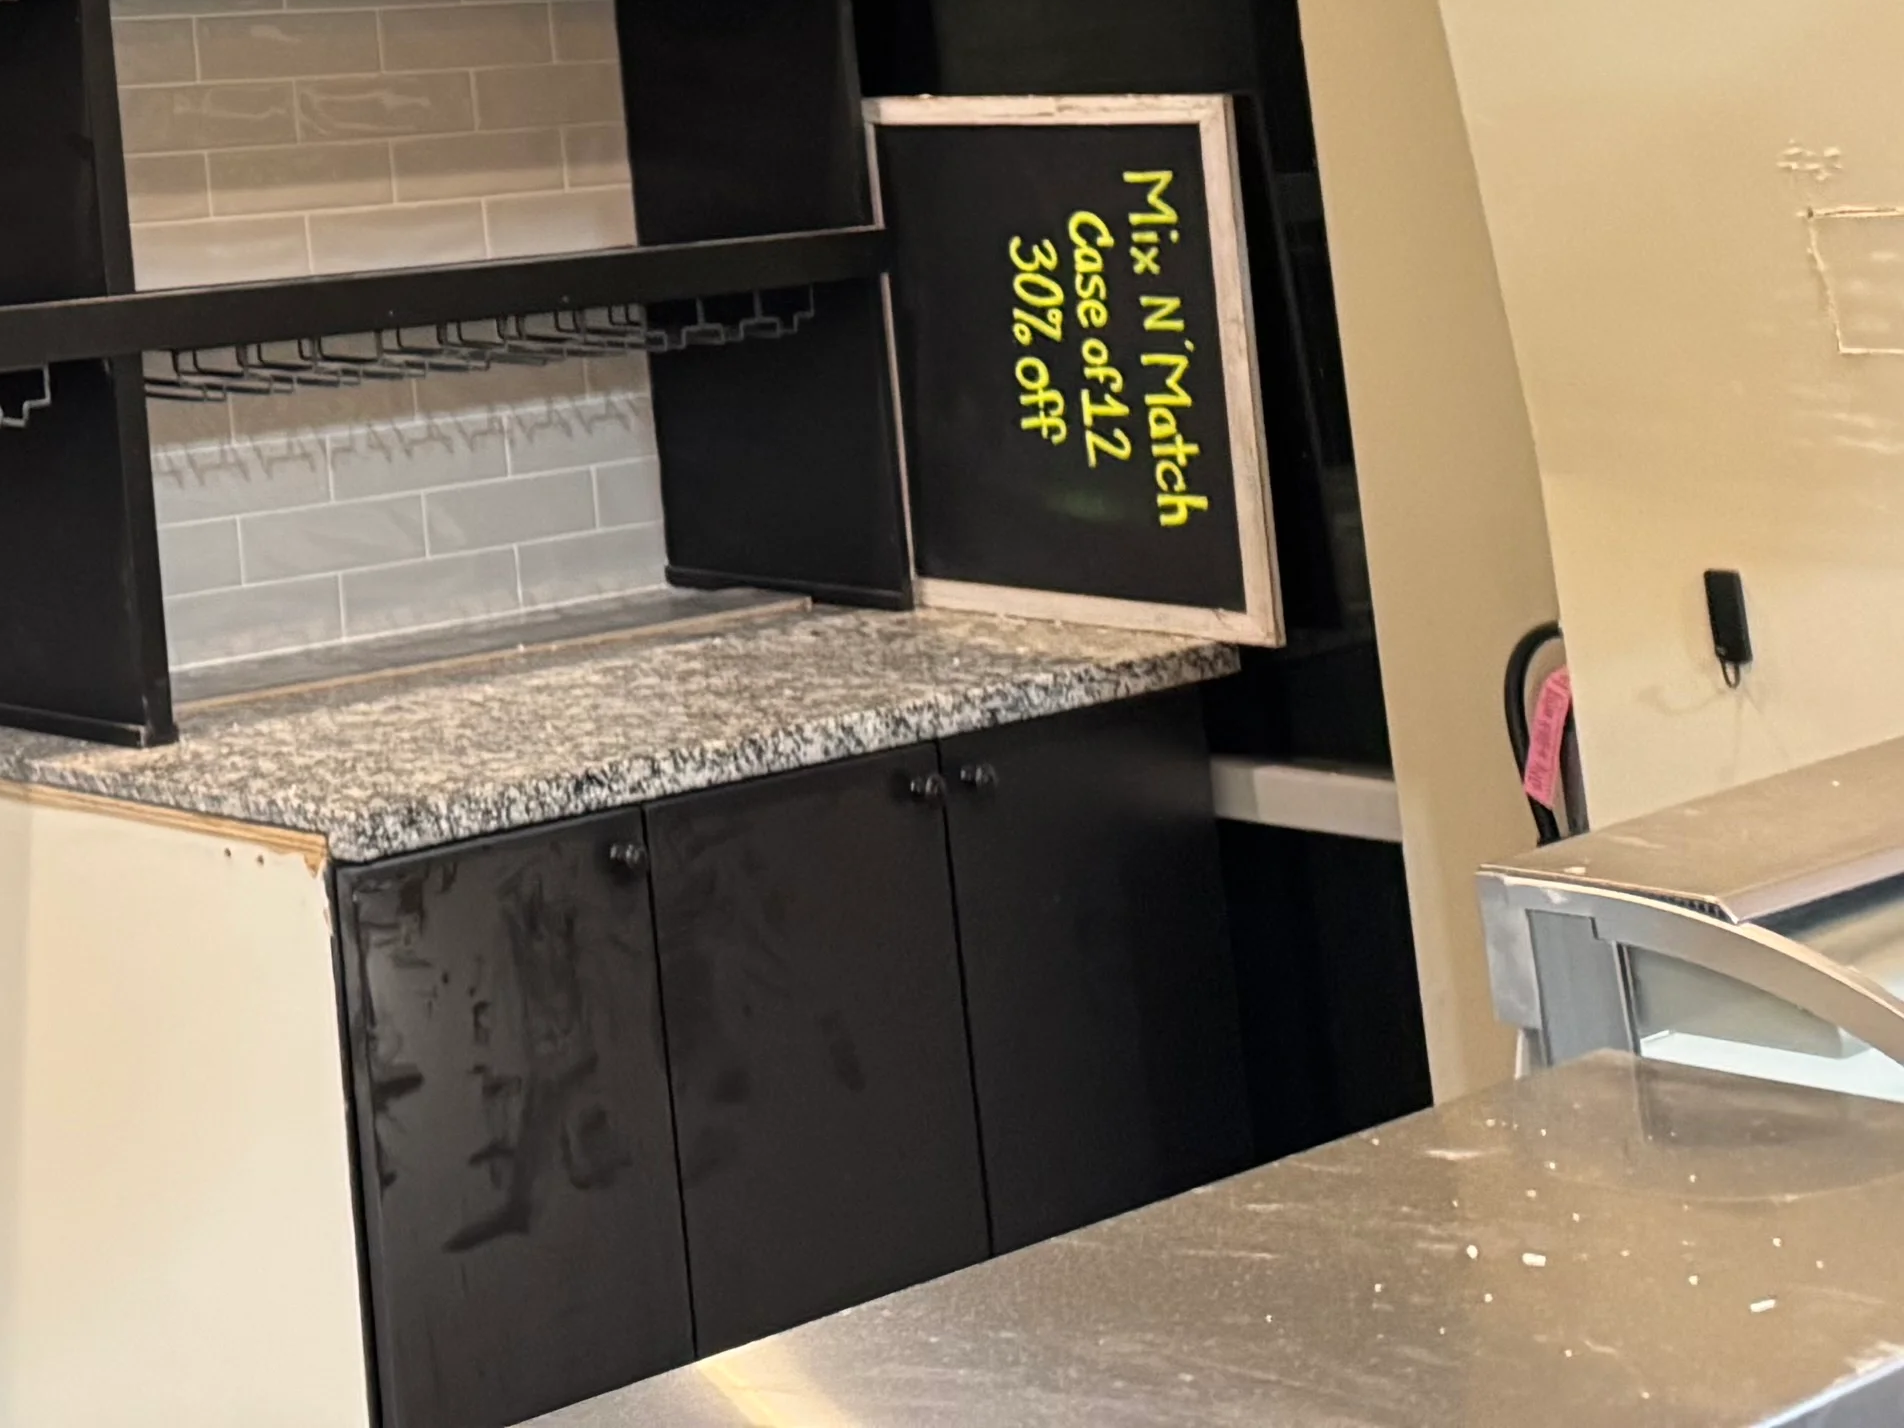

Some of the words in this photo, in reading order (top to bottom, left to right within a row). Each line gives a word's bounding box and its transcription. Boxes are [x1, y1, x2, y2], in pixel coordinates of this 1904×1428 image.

[1068, 210, 1114, 328] Case
[1122, 170, 1179, 274] Mix
[1009, 236, 1064, 345] 30%
[1014, 357, 1067, 445] off
[1081, 338, 1125, 392] of
[1080, 388, 1132, 467] 12
[1141, 352, 1209, 527] Match
